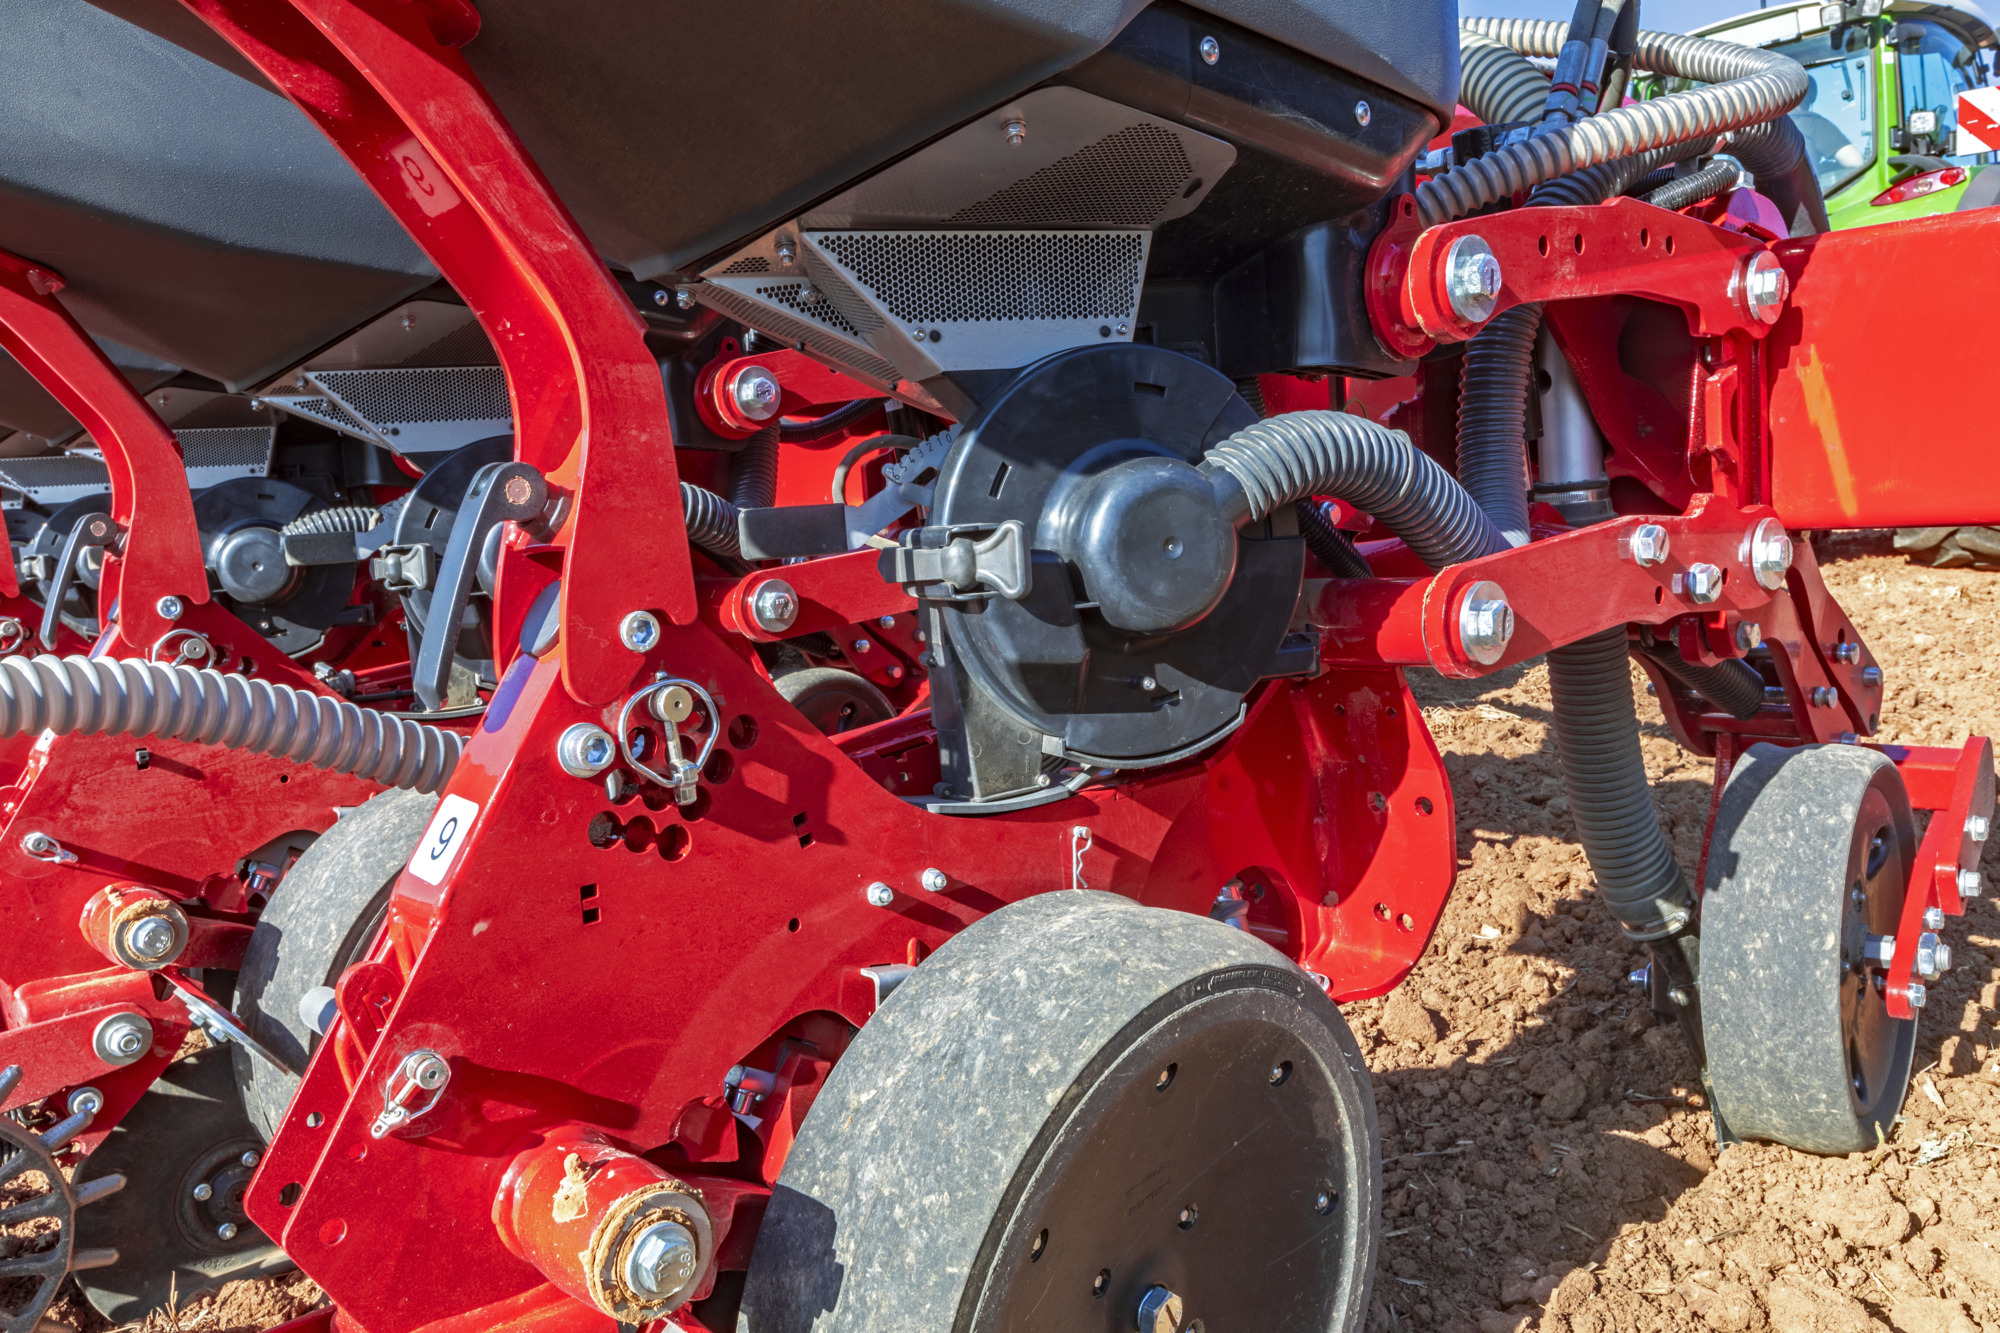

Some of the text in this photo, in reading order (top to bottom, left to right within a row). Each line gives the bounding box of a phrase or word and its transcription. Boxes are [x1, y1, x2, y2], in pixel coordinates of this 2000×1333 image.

[892, 472, 900, 480] 6
[899, 463, 908, 472] 5
[917, 449, 924, 458] 3
[926, 442, 934, 452] 2
[937, 437, 943, 446] 1
[945, 433, 952, 443] 0
